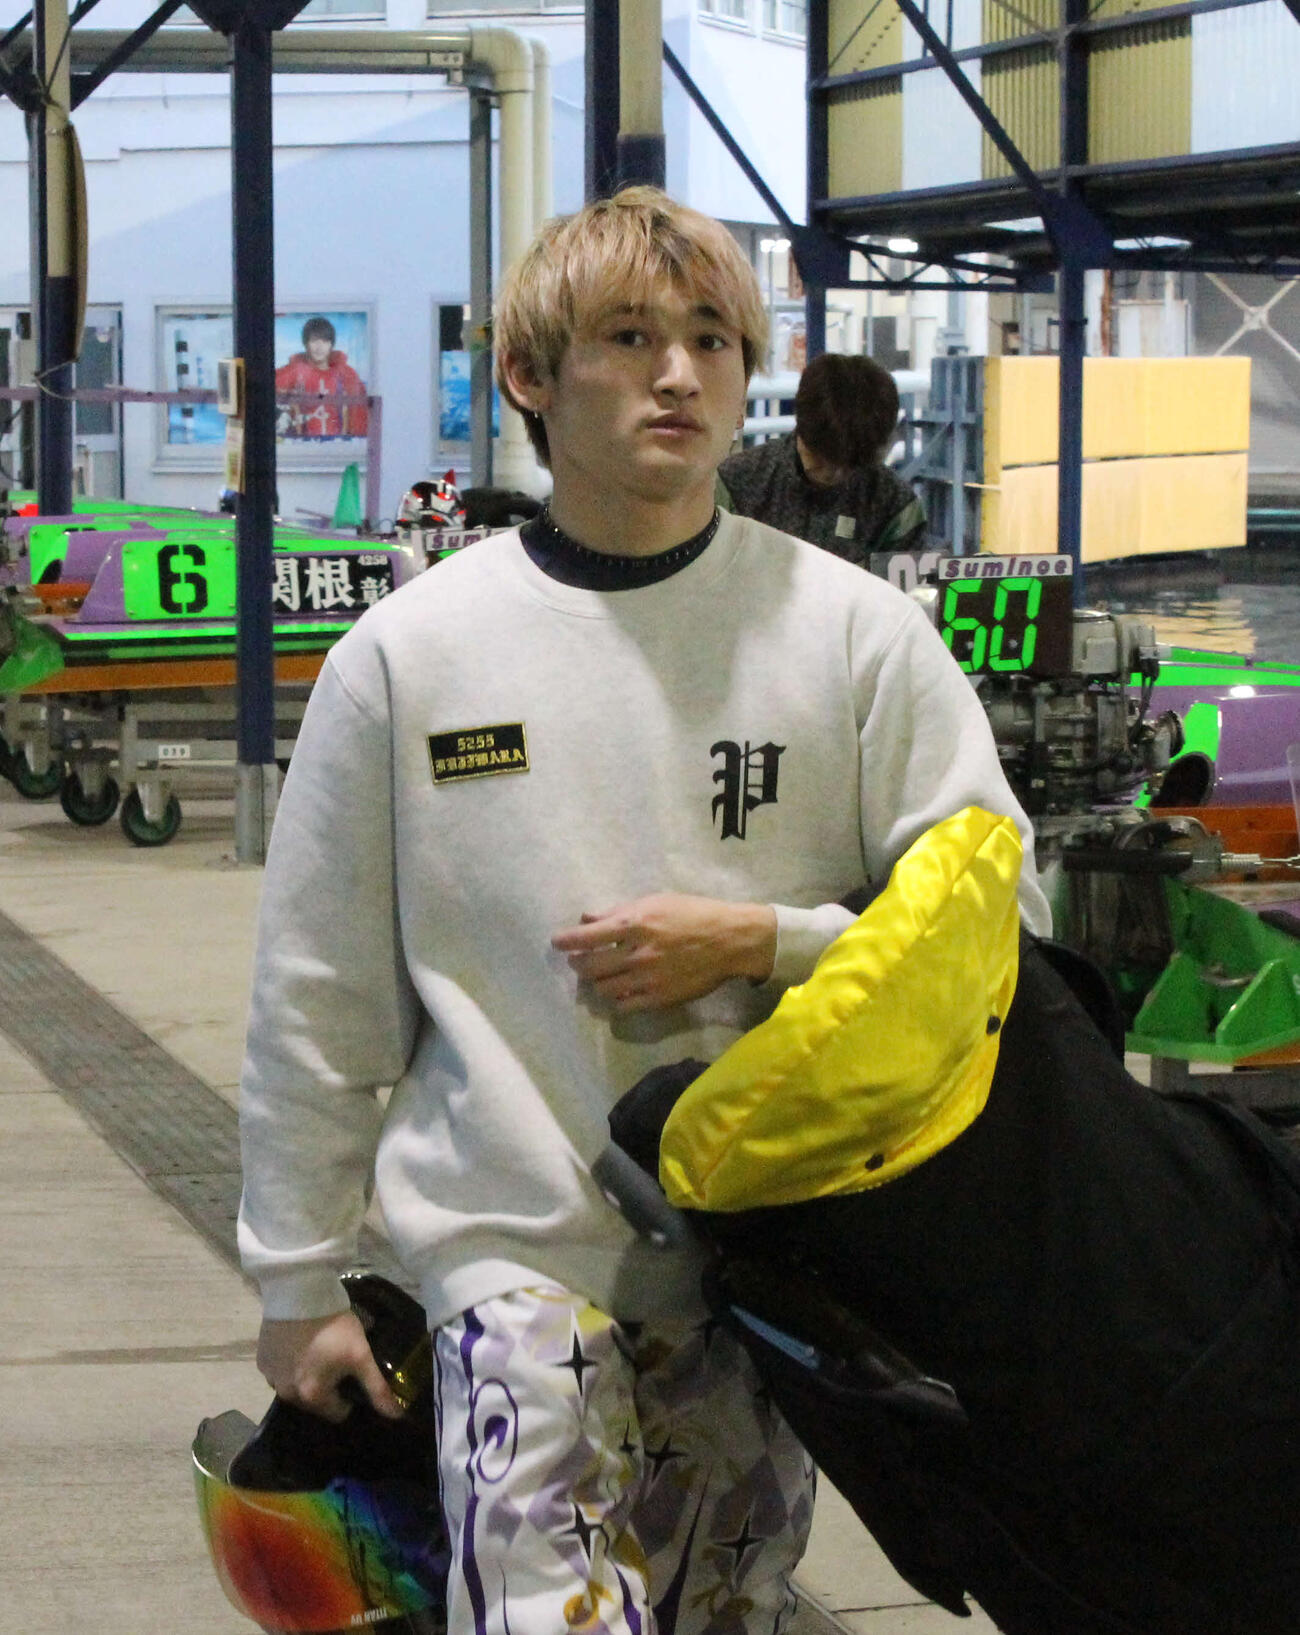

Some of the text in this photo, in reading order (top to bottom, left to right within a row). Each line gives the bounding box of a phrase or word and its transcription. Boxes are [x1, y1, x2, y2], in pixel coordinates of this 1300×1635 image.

[157, 544, 208, 614] 6
[945, 557, 1068, 578] Suminoe
[942, 578, 1042, 672] 60
[457, 733, 495, 752] 5255
